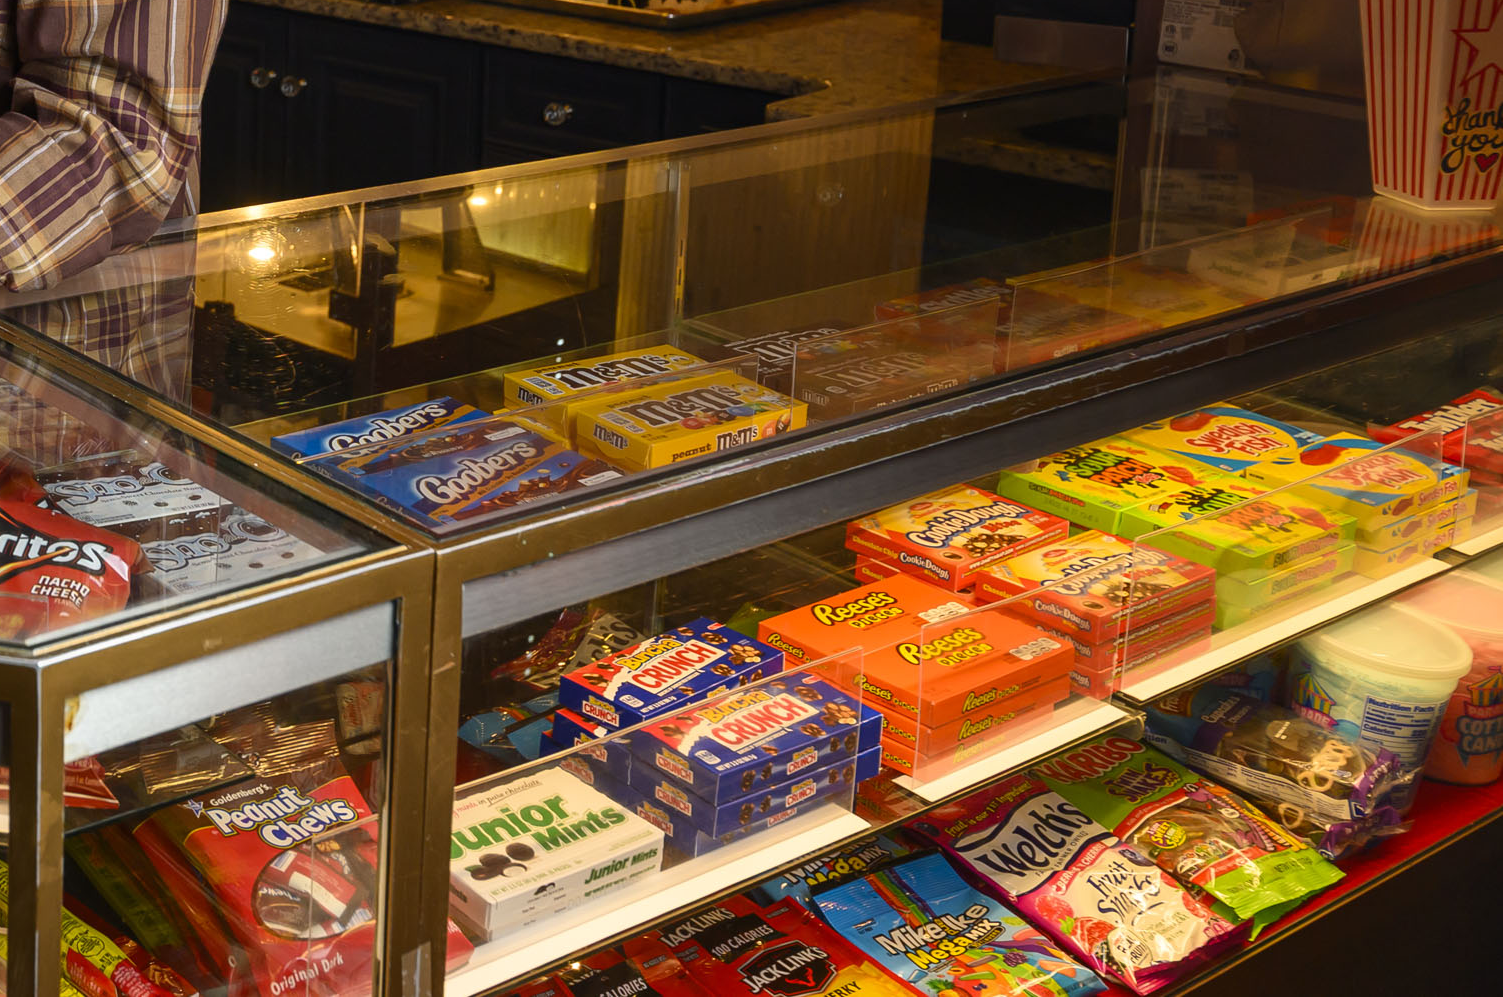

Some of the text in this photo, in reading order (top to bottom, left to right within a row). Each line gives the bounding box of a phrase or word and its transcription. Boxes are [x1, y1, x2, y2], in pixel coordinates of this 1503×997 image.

[544, 354, 670, 390] m&m's
[617, 384, 742, 429] m&m's
[672, 425, 758, 462] peanut m&m's
[1184, 422, 1272, 453] Swedish
[1223, 434, 1287, 457] Fish
[415, 440, 538, 504] Goobers
[1065, 451, 1128, 476] SOUR
[1092, 458, 1154, 488] PATCH
[31, 583, 83, 608] CHEESE
[39, 575, 91, 597] NACHO
[813, 591, 897, 626] Reese's
[621, 639, 682, 670] Buncha
[768, 633, 804, 659] Reese's
[897, 627, 984, 665] Reese's
[632, 642, 716, 689] CRUNCH
[853, 673, 893, 701] Reese's
[962, 687, 998, 713] Reese's
[583, 703, 619, 727] CRUNCH
[700, 692, 771, 724] Buncha
[1368, 698, 1412, 712] Nutrition
[711, 698, 809, 746] CRUNCH
[959, 716, 993, 740] Reese's
[1363, 723, 1396, 735] Calories
[656, 754, 693, 783] CRUNCH
[1038, 737, 1146, 785] HARIBO
[204, 785, 312, 836] Peanut
[210, 783, 271, 807] Goldenberg's
[261, 799, 357, 848] Chews
[531, 808, 627, 851] Mints
[975, 802, 1094, 877] Welch's
[585, 857, 630, 884] Junior
[631, 848, 658, 866] Mints
[863, 845, 888, 863] MIX
[660, 916, 702, 948] JACK
[712, 924, 775, 959] 100 CALORIES
[874, 921, 944, 955] Mike
[906, 918, 1002, 970] Mega MIX
[270, 963, 320, 997] Original
[743, 946, 829, 994] JACK LINK'S
